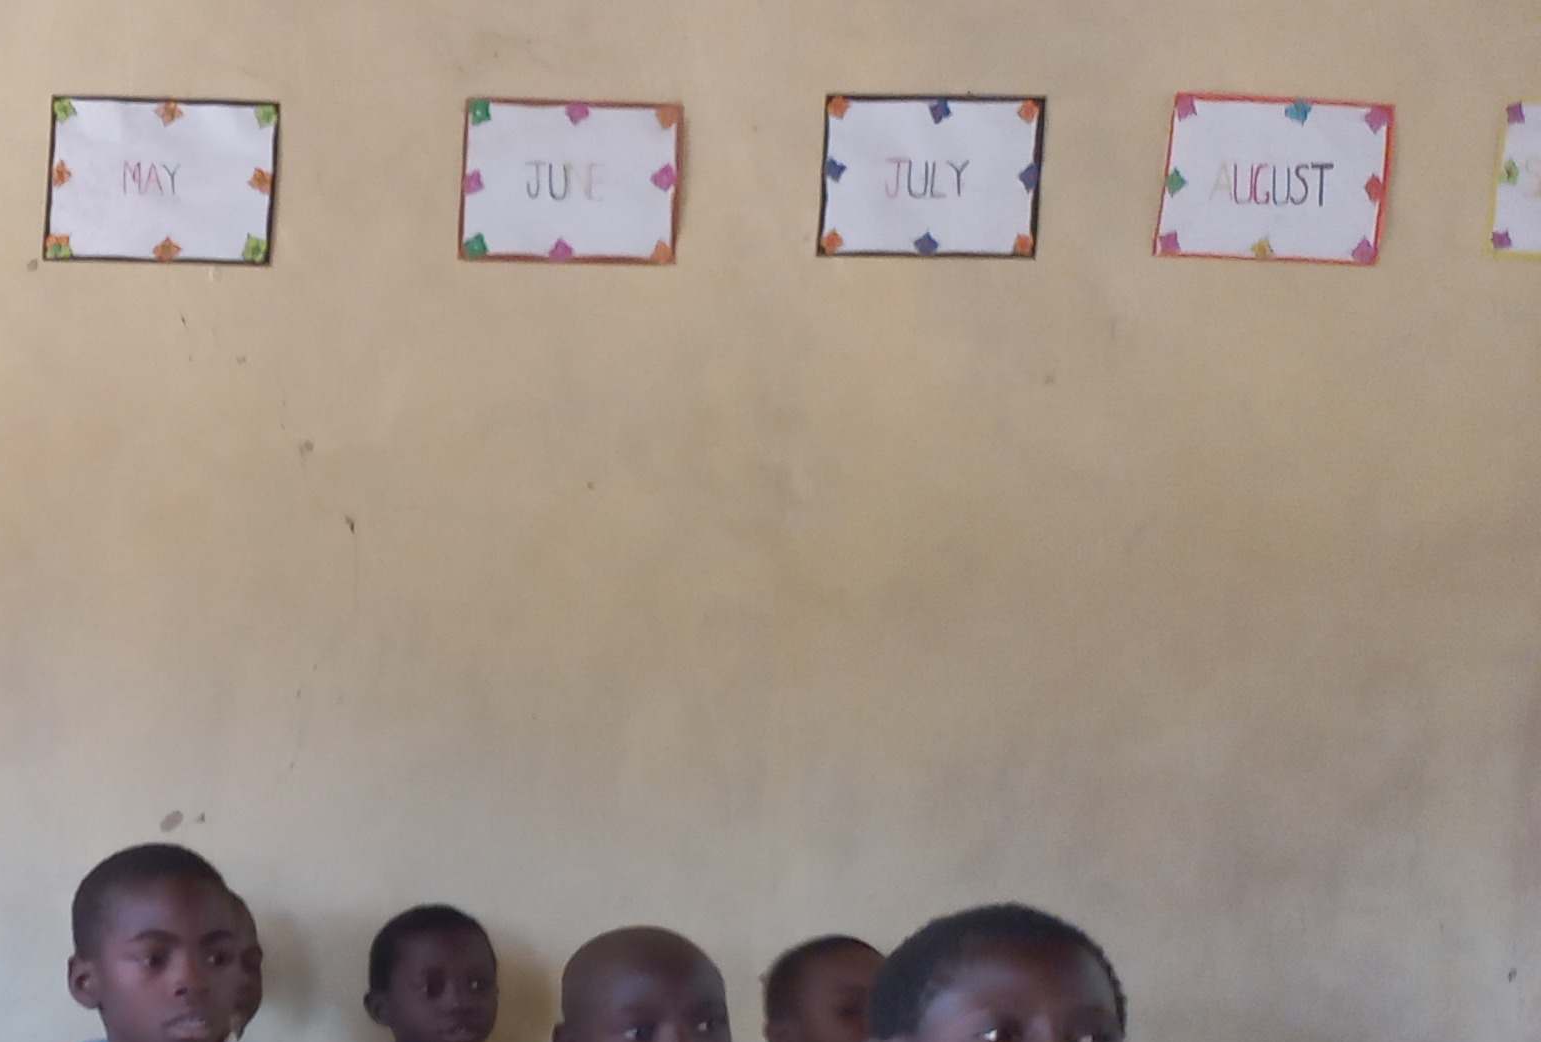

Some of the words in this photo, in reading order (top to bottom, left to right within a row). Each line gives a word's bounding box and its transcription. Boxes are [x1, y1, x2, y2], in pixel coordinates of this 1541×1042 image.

[122, 160, 181, 196] MAY
[885, 156, 970, 199] JULY
[1208, 161, 1335, 207] AUGUST
